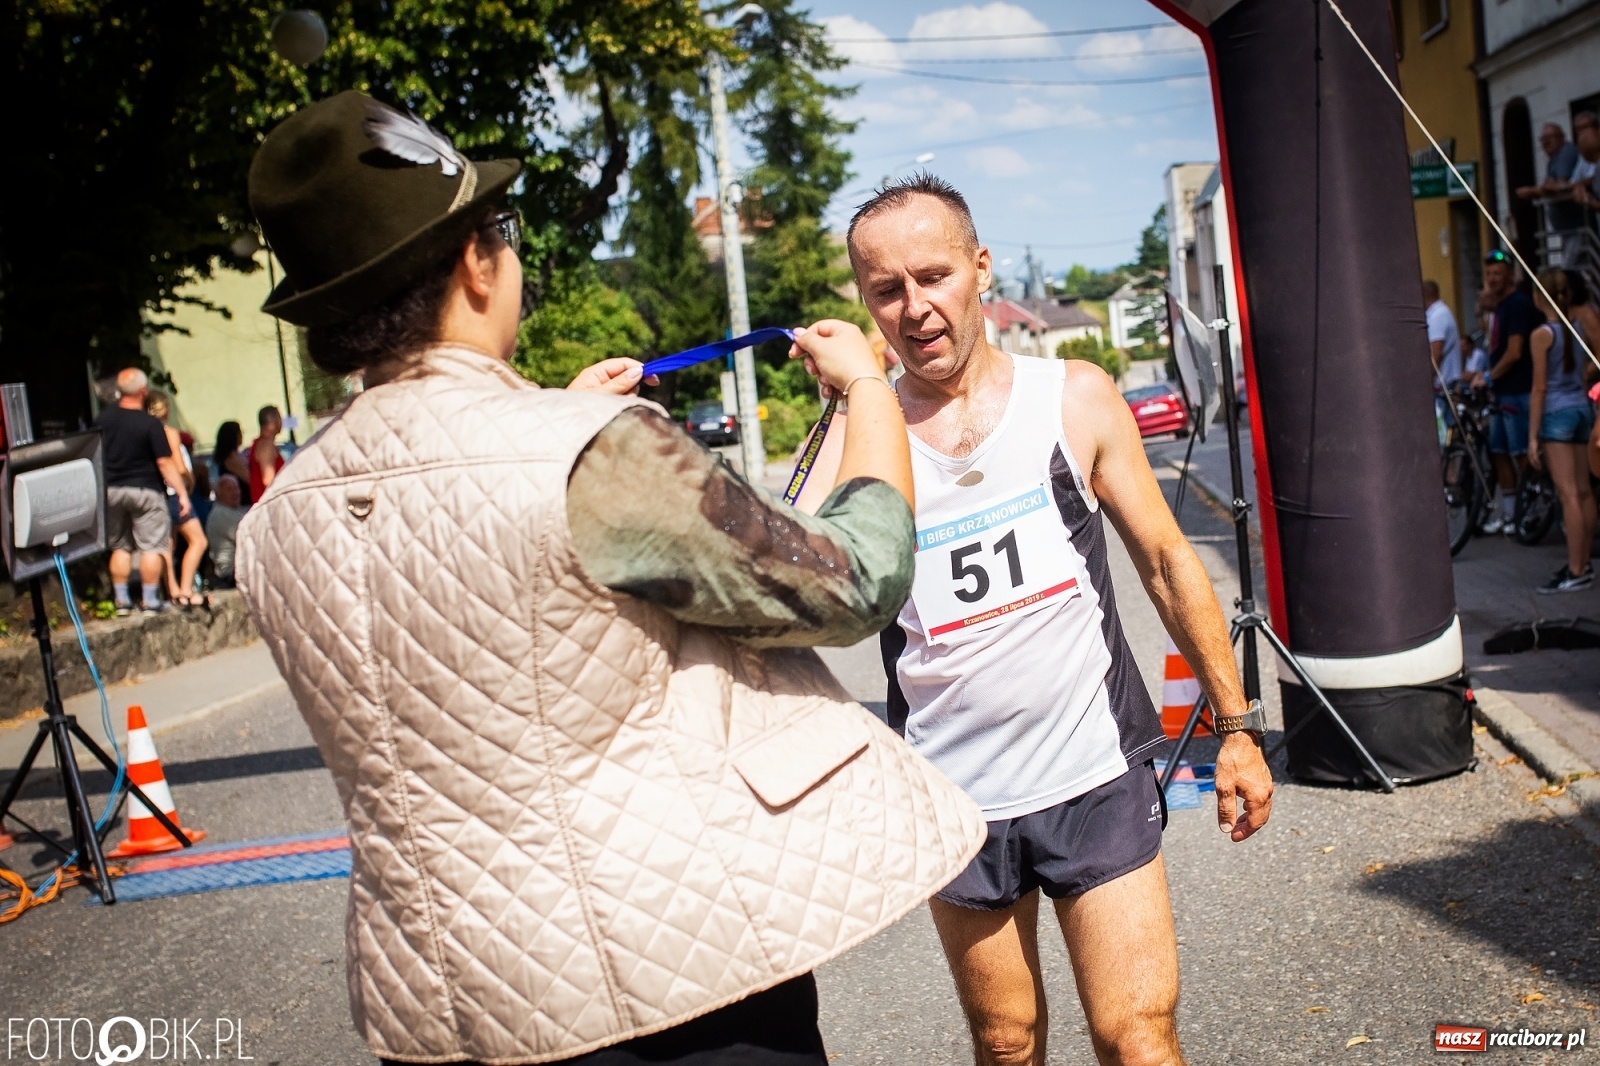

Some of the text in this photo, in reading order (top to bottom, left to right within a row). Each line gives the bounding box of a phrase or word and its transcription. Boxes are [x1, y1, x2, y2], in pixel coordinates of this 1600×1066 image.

[788, 471, 806, 498] PRZED
[927, 526, 956, 545] BIEG
[958, 493, 1043, 534] KRZANOWICKI
[950, 528, 1024, 604] 51
[963, 610, 1001, 626] Krzanowice,
[1000, 605, 1009, 613] 28
[1009, 601, 1024, 611] lipca
[1025, 594, 1040, 605] 2019
